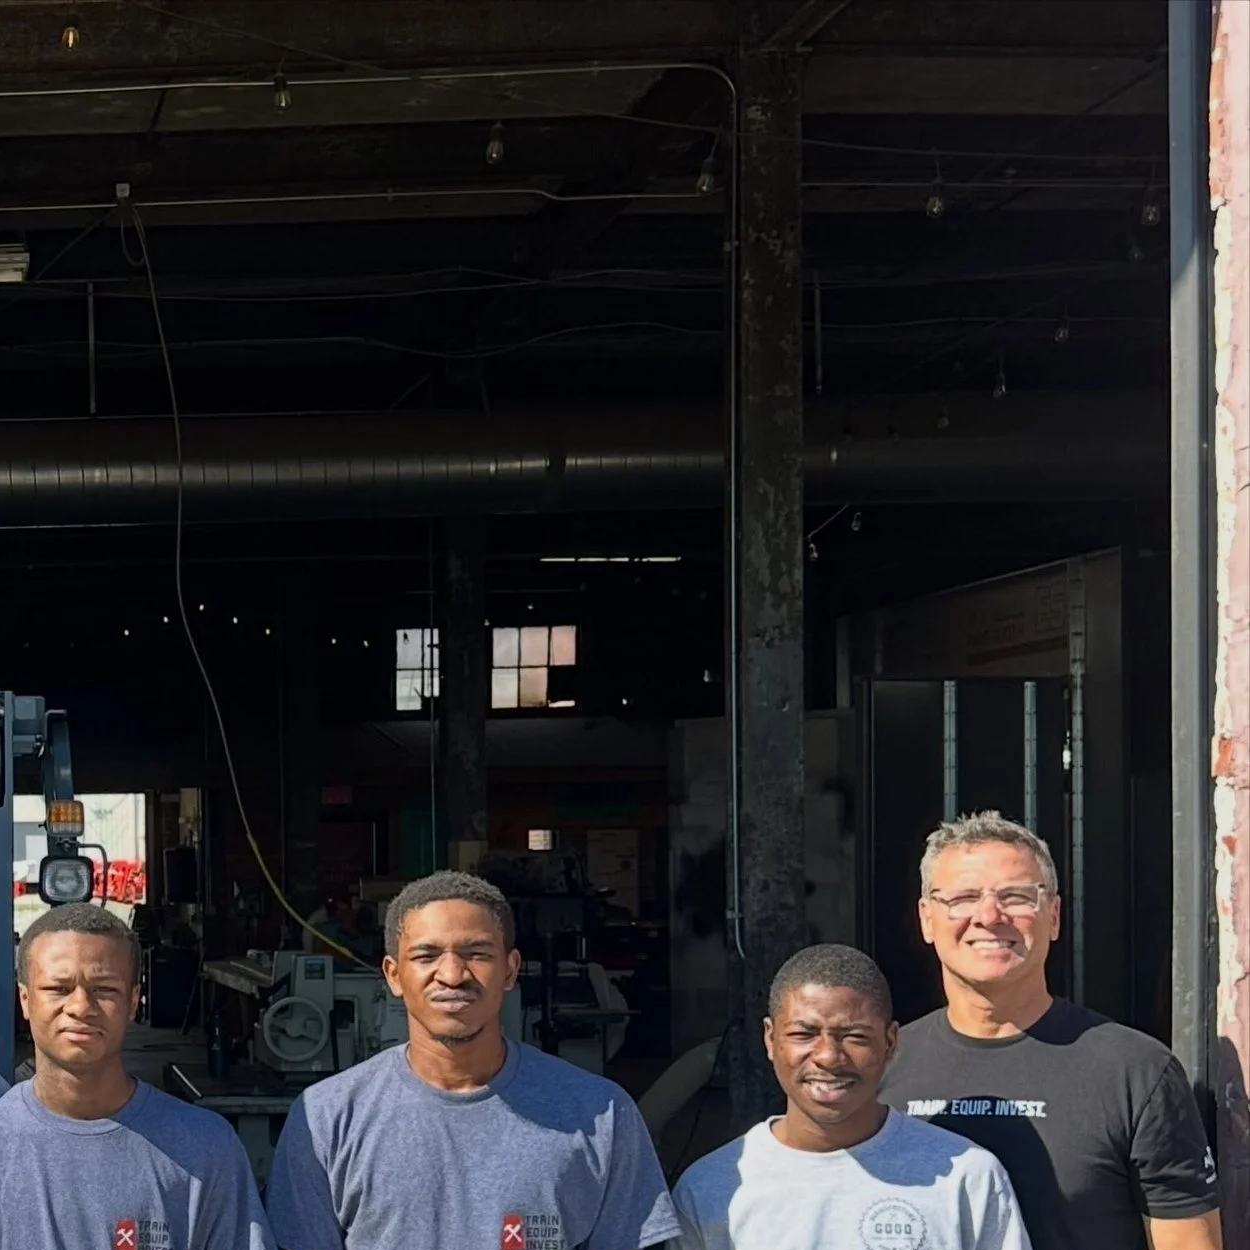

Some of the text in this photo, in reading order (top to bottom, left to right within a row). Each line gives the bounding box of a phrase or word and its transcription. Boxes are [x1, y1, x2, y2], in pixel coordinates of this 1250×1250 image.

[951, 1099, 992, 1116] EQUIP.
[995, 1099, 1047, 1118] INVEST.
[526, 1214, 560, 1226] TRAIN
[526, 1227, 559, 1239] EQUIP
[874, 1223, 913, 1235] GOOD
